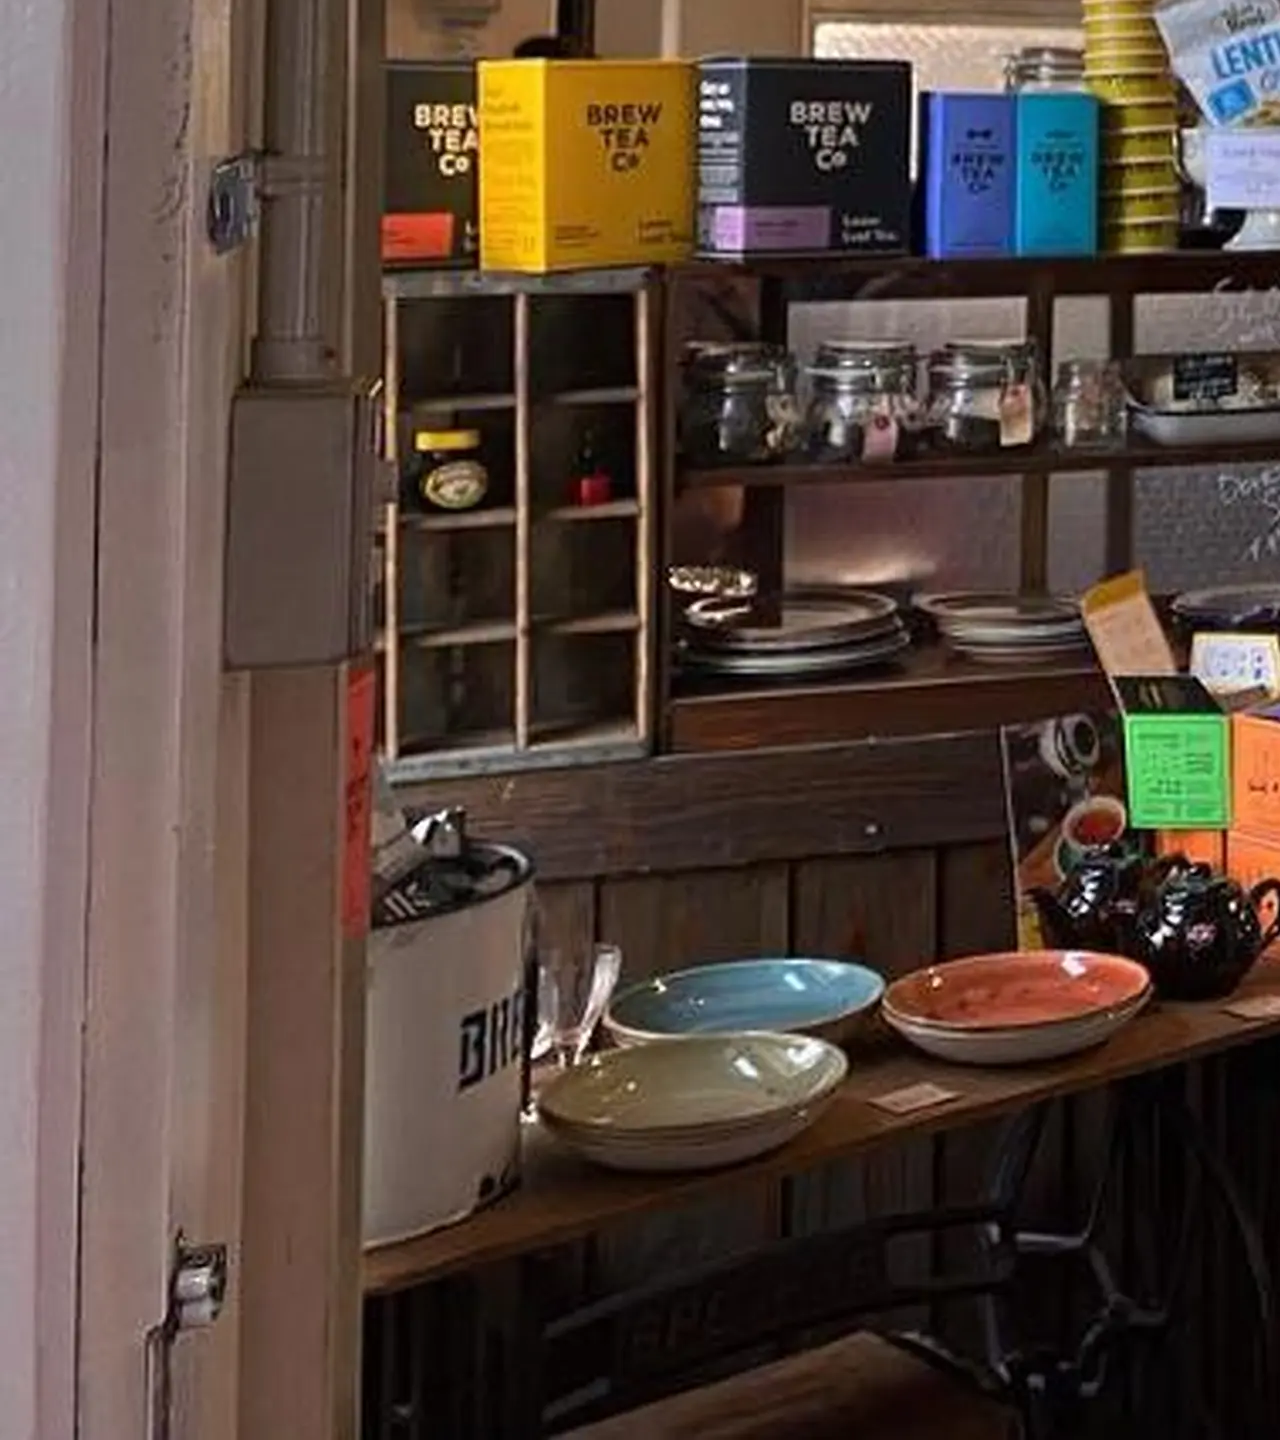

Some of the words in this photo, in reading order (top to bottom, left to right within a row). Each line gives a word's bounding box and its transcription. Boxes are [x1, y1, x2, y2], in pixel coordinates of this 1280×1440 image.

[586, 101, 663, 126] BREW
[789, 101, 873, 126] BREW
[429, 130, 478, 151] TEA
[600, 127, 650, 149] TEA
[804, 126, 859, 148] TEA
